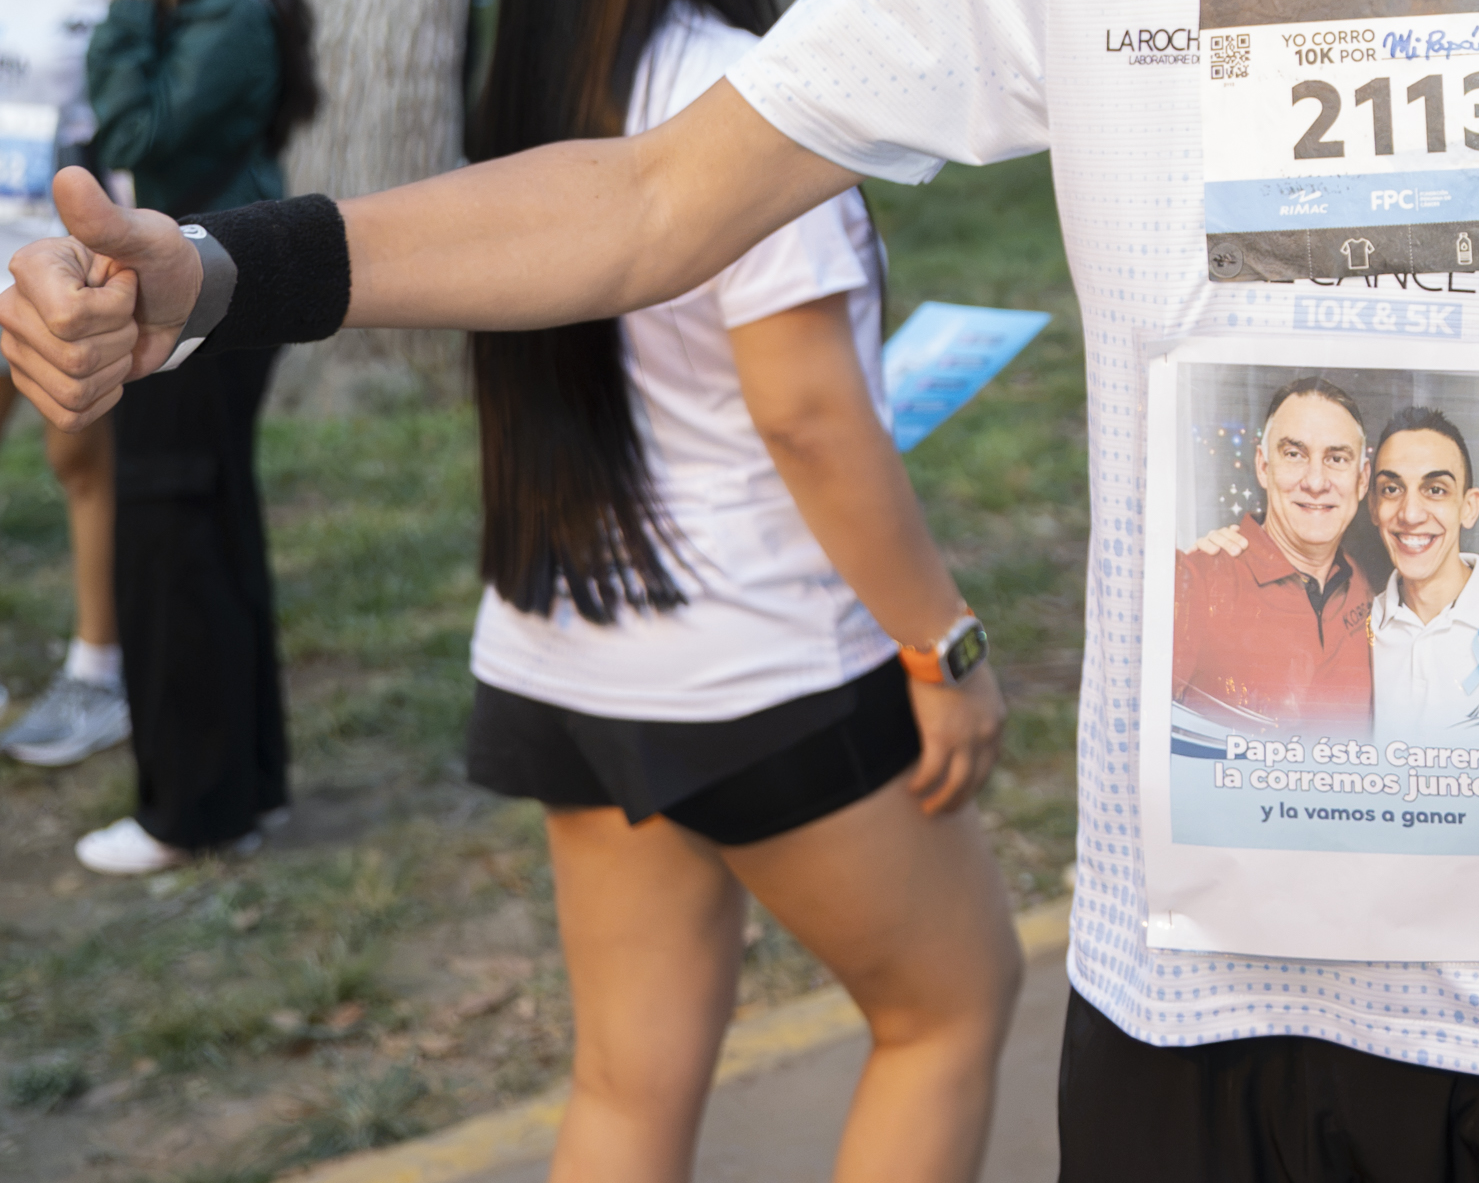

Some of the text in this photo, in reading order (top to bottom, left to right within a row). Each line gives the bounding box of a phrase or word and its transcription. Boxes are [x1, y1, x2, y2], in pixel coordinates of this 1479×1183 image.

[1281, 28, 1375, 48] YO CORRO
[1382, 29, 1421, 60] Mi
[1128, 54, 1190, 65] LABORATOIRE
[1294, 47, 1377, 66] 10K POR
[1279, 203, 1329, 216] RIMAC
[1370, 189, 1415, 211] FPC
[1301, 299, 1456, 335] 10K & 5K
[1226, 734, 1305, 768] Papá
[1312, 736, 1379, 766] ésta
[1214, 761, 1243, 789] la
[1249, 768, 1401, 795] corremos
[1260, 801, 1467, 828] y la vamos a ganar
